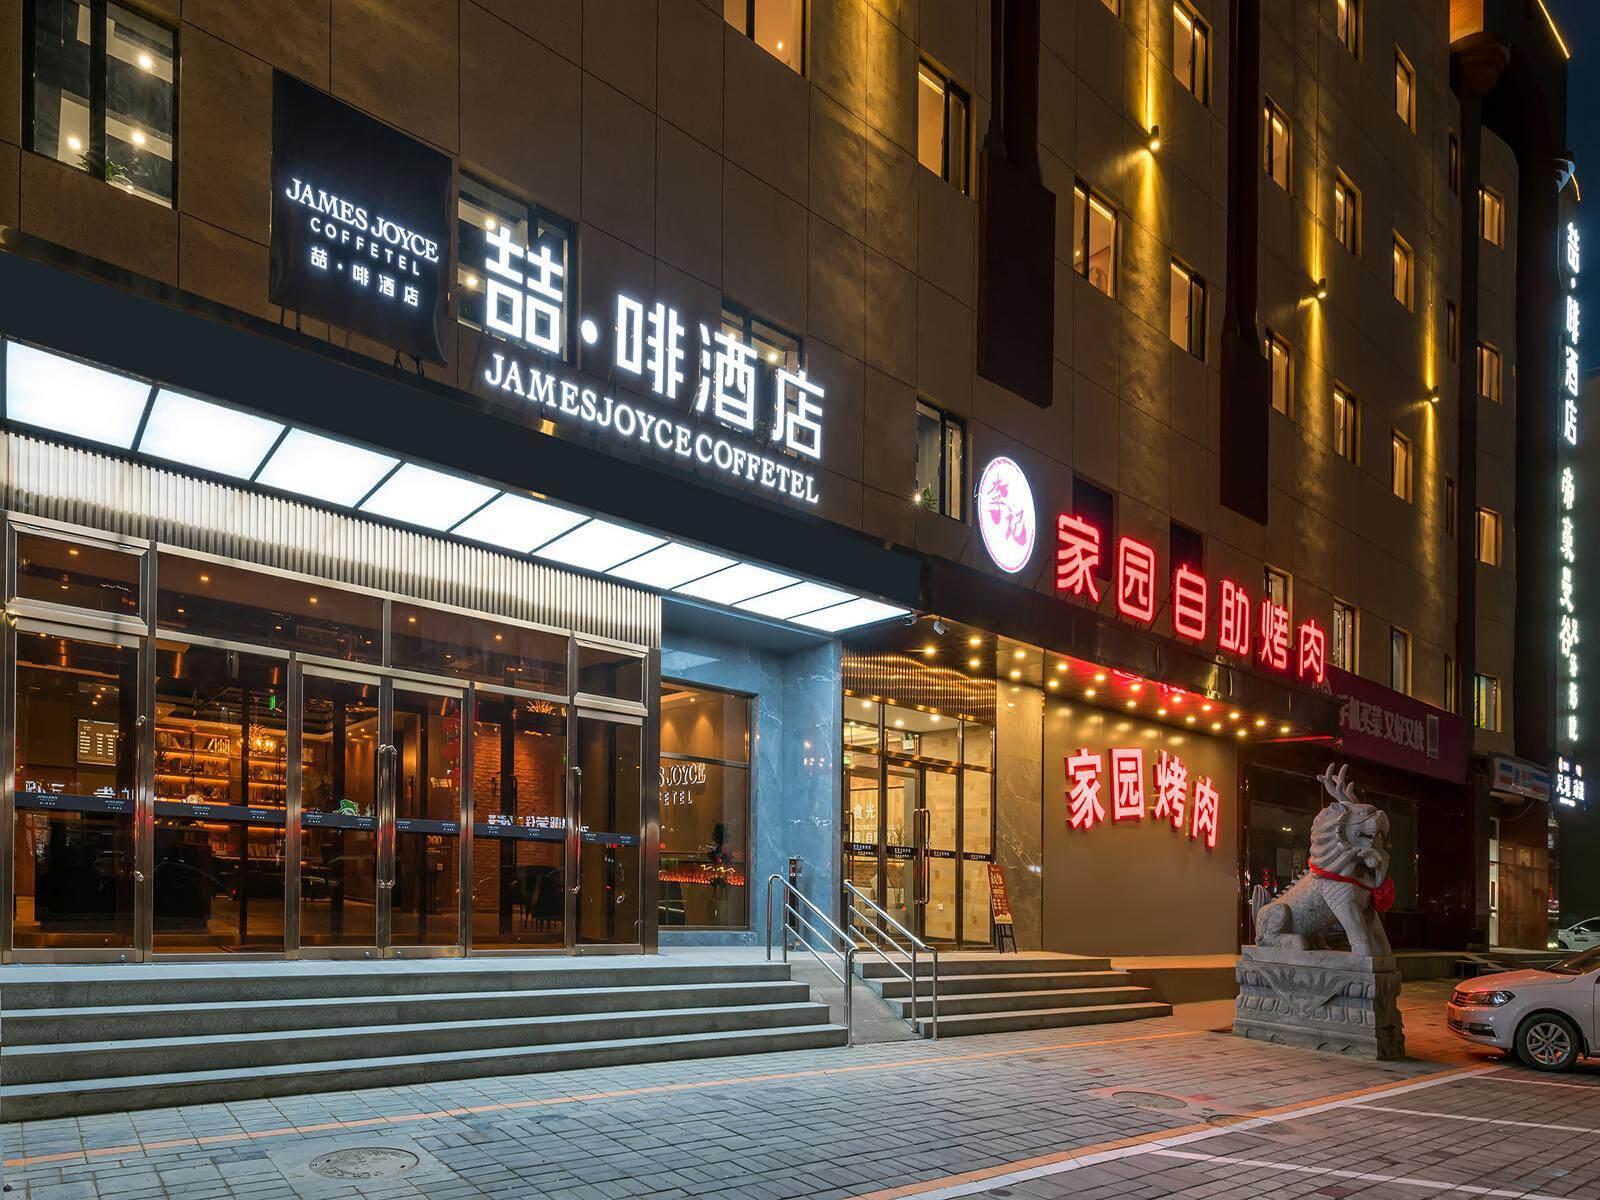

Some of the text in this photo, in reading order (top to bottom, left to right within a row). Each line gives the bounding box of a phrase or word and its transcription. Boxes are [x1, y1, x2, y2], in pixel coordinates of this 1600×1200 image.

[285, 177, 440, 263] JAMES JOYCE
[310, 217, 421, 277] COFFETEL
[1056, 512, 1326, 684] 家园自助烤肉
[1065, 747, 1220, 849] 家园烤肉
